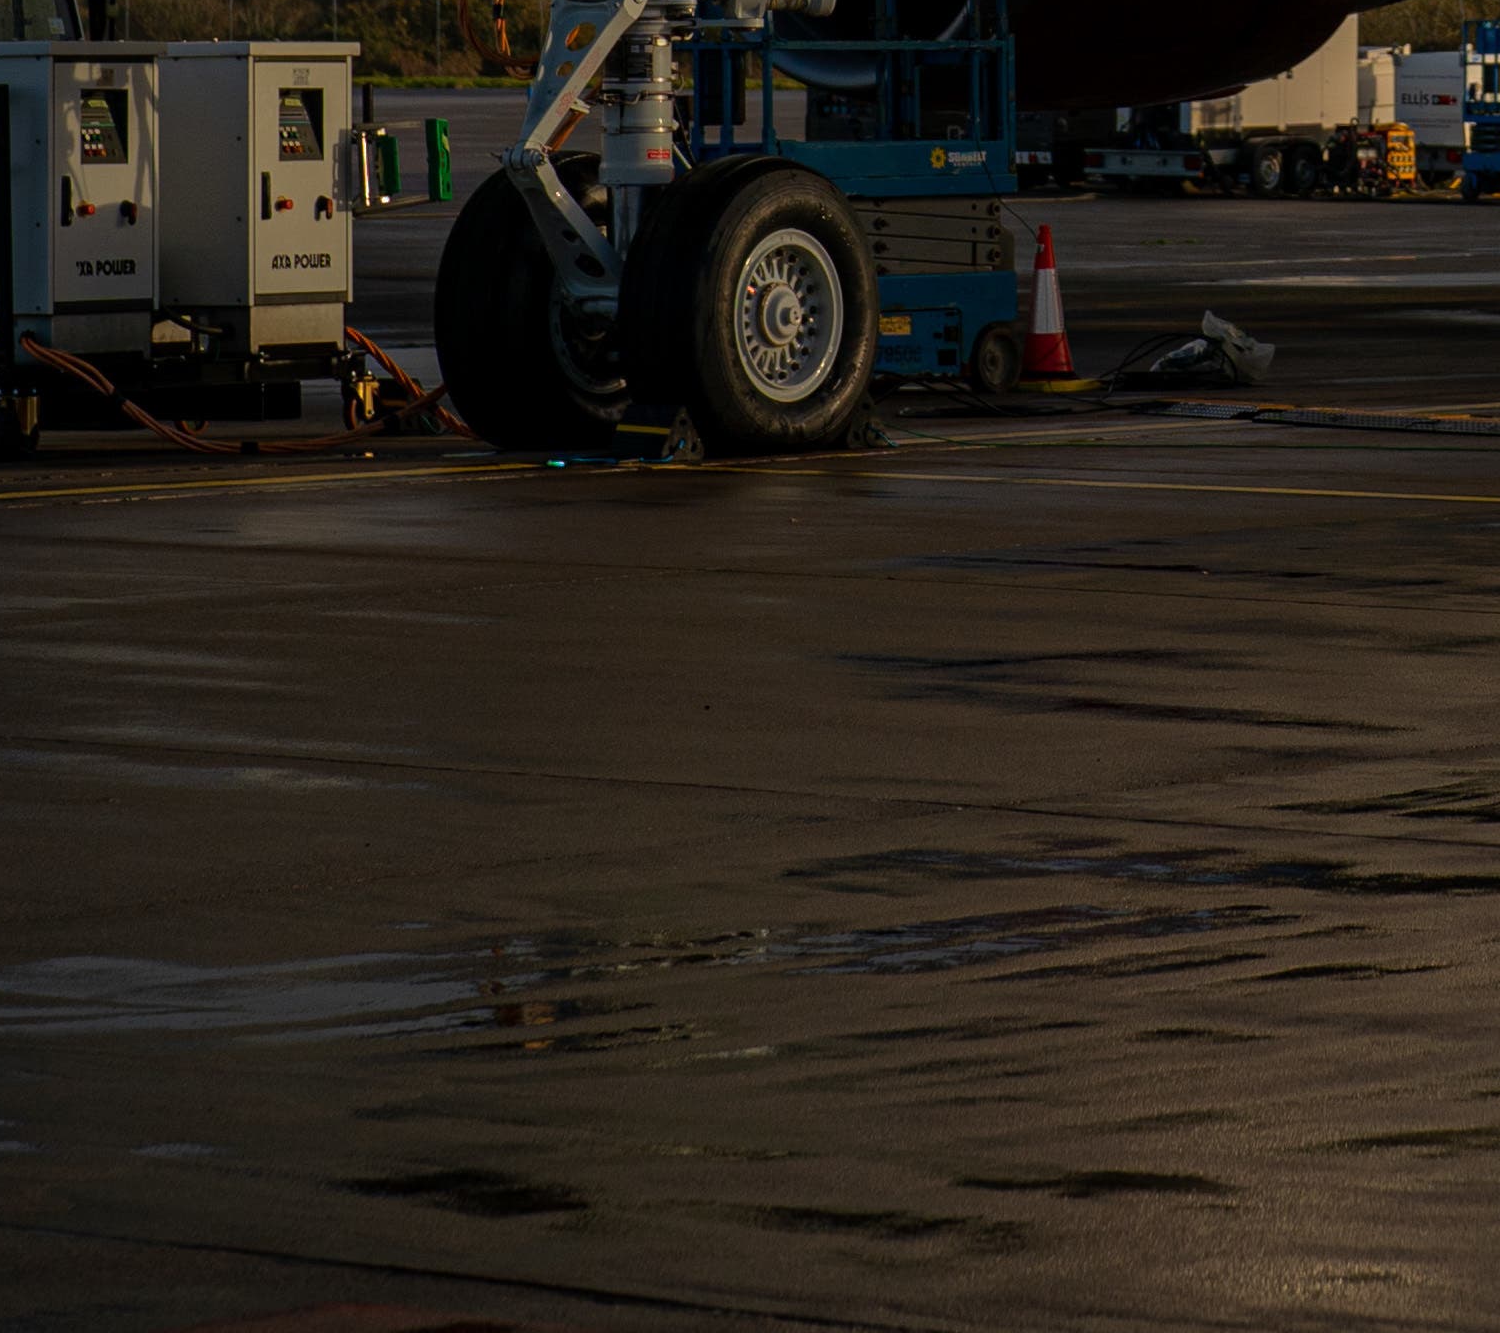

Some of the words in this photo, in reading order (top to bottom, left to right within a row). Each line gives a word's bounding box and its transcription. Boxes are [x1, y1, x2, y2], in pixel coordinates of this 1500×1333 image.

[76, 260, 94, 276] XA
[96, 259, 136, 276] POWER
[271, 255, 292, 270] AXA
[294, 253, 331, 269] POWER
